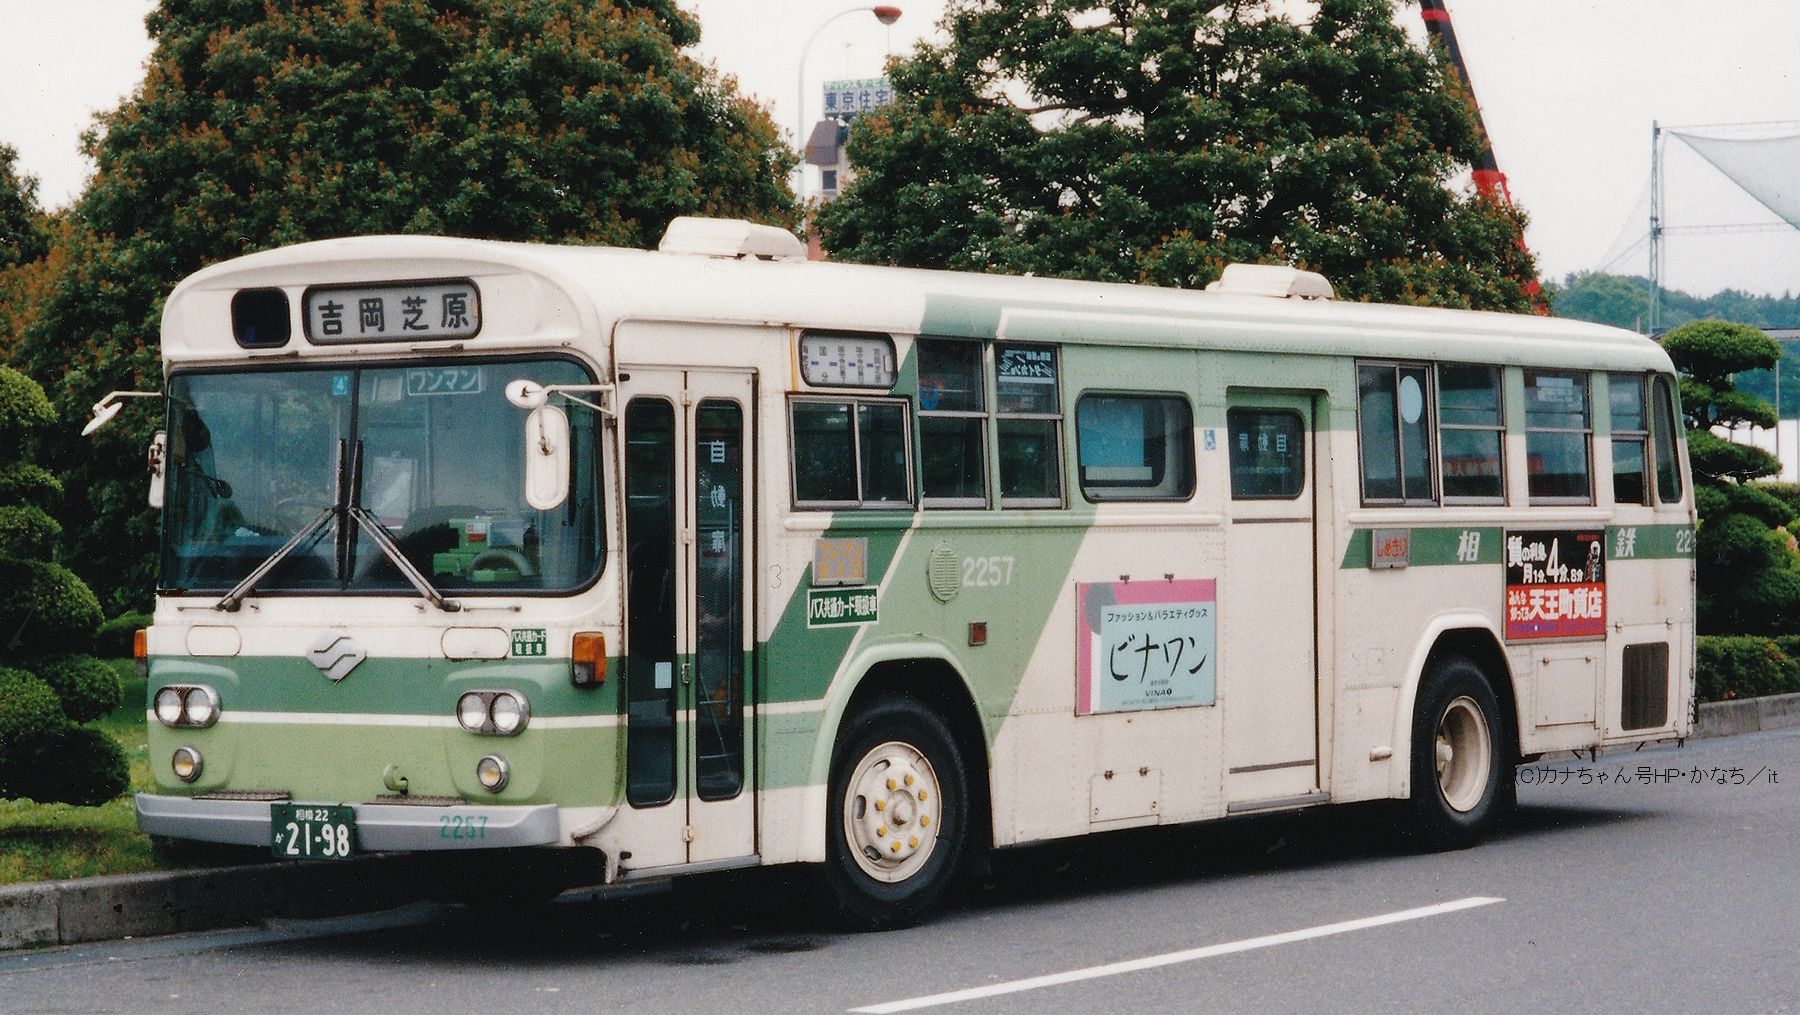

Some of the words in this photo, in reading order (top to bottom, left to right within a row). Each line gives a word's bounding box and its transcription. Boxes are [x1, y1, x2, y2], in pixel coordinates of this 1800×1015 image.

[318, 292, 470, 336] 吉岡芝原
[410, 369, 478, 391] ワンマン
[1457, 530, 1480, 562] 相
[1614, 527, 1637, 558] 鉄
[963, 556, 1015, 588] 2257
[1109, 633, 1208, 685] ビナワン
[286, 821, 350, 857] 21-98
[439, 815, 489, 840] 2257
